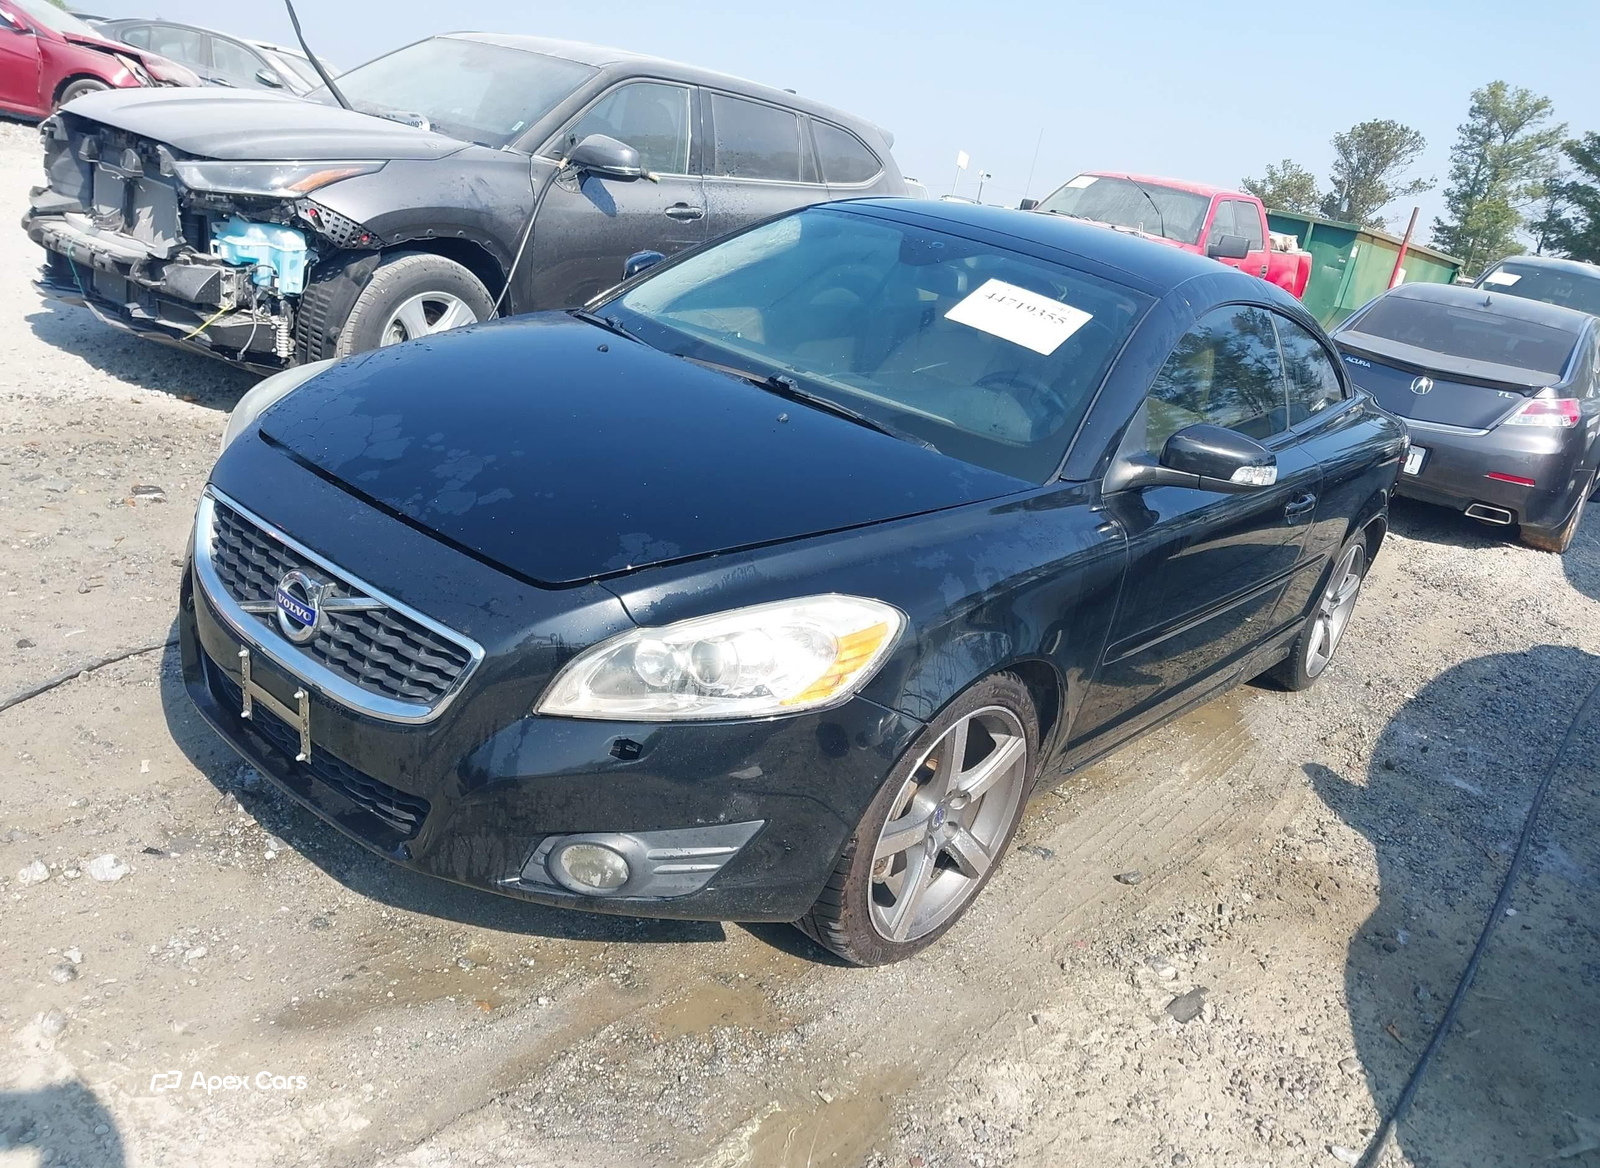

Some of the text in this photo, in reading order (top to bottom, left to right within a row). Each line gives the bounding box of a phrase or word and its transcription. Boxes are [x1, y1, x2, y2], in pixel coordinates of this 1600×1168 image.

[984, 292, 1068, 325] 44719355
[1345, 356, 1371, 369] ACURA
[1497, 390, 1514, 400] TL
[277, 592, 312, 622] VOLVO
